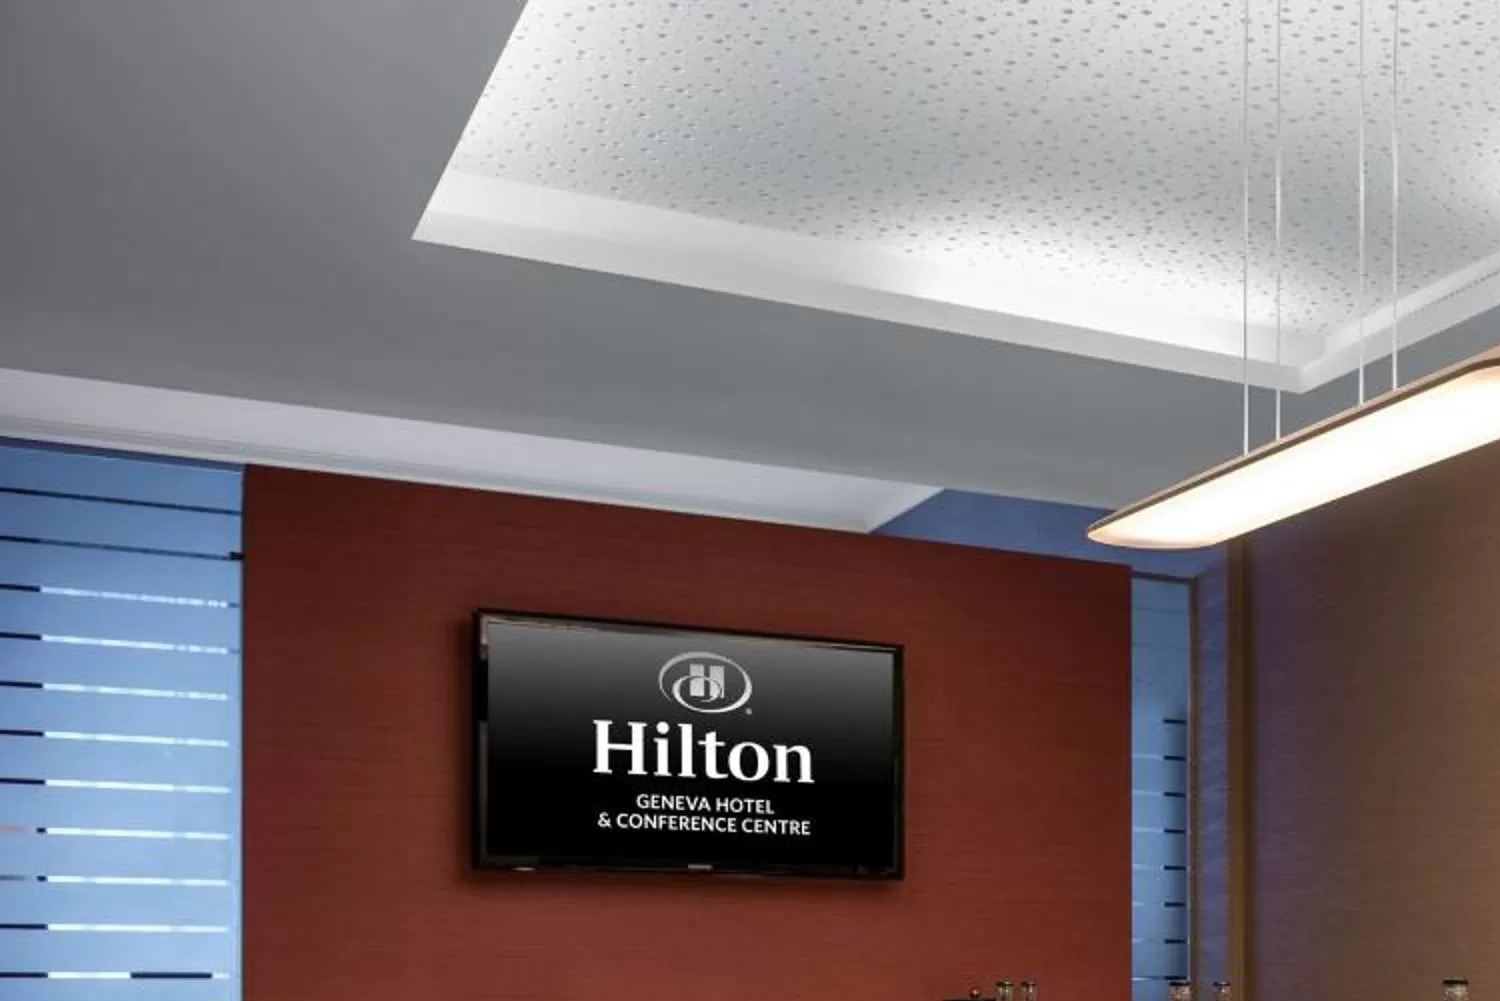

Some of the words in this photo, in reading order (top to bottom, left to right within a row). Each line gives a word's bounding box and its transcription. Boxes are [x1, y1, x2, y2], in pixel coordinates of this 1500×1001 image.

[592, 719, 815, 783] Hilton
[636, 793, 711, 812] GENEVA
[716, 798, 775, 815] HOTEL
[598, 812, 612, 828] &
[616, 813, 737, 833] CONFERENCE
[742, 818, 811, 837] CENTRE
